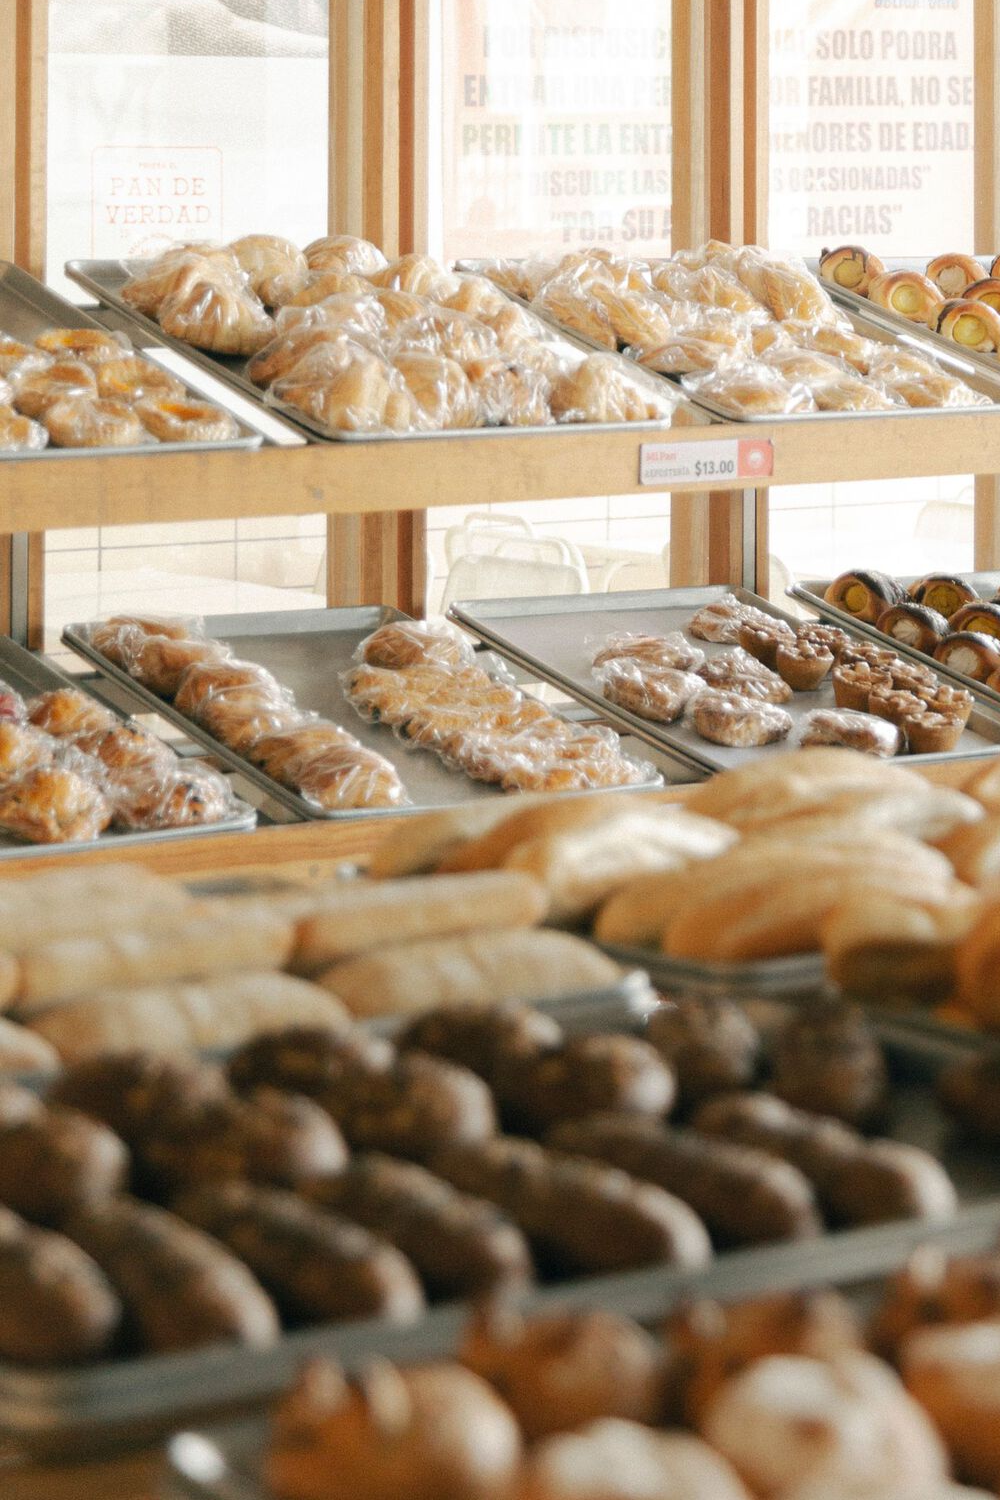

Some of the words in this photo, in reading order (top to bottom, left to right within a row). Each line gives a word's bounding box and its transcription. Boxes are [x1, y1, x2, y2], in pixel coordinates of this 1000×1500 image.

[815, 29, 874, 61] SOLO
[881, 30, 958, 61] PODRA
[807, 75, 904, 108] FAMILIA,
[911, 75, 941, 106] NO
[948, 75, 973, 106] SE
[583, 123, 612, 155] LA
[879, 121, 907, 152] DE
[110, 176, 161, 196] PAN
[172, 176, 206, 196] DE
[632, 169, 669, 196] LAS
[105, 204, 211, 225] VERDAD
[621, 208, 655, 242] SU
[790, 203, 903, 238] RACIAS"
[694, 459, 735, 476] $13.00
